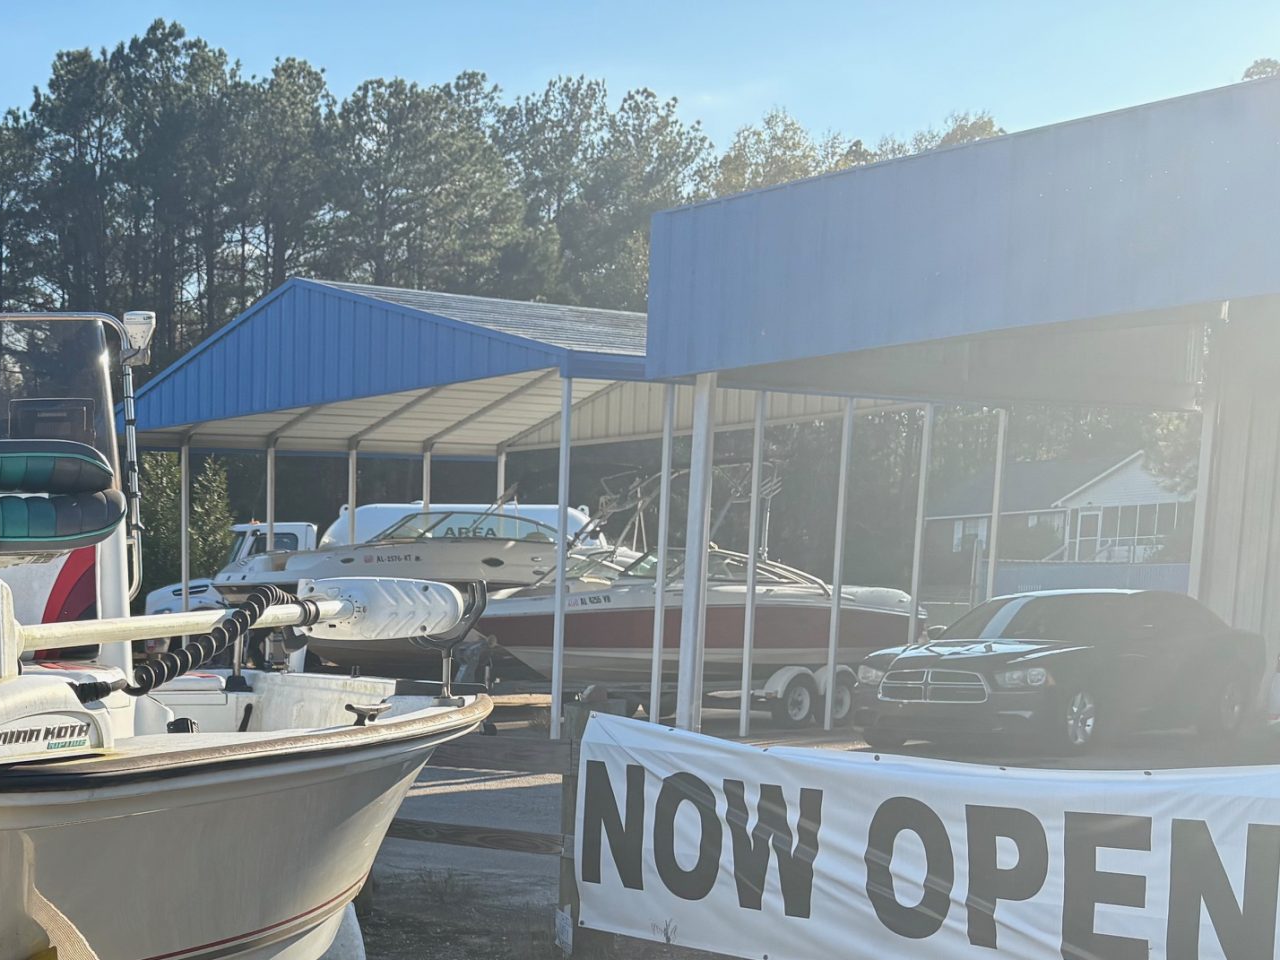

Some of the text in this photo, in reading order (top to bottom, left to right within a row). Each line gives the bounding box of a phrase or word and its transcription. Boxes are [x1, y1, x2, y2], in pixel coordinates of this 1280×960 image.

[444, 527, 496, 537] AREA
[43, 723, 91, 741] KOTA
[581, 760, 823, 919] NOW
